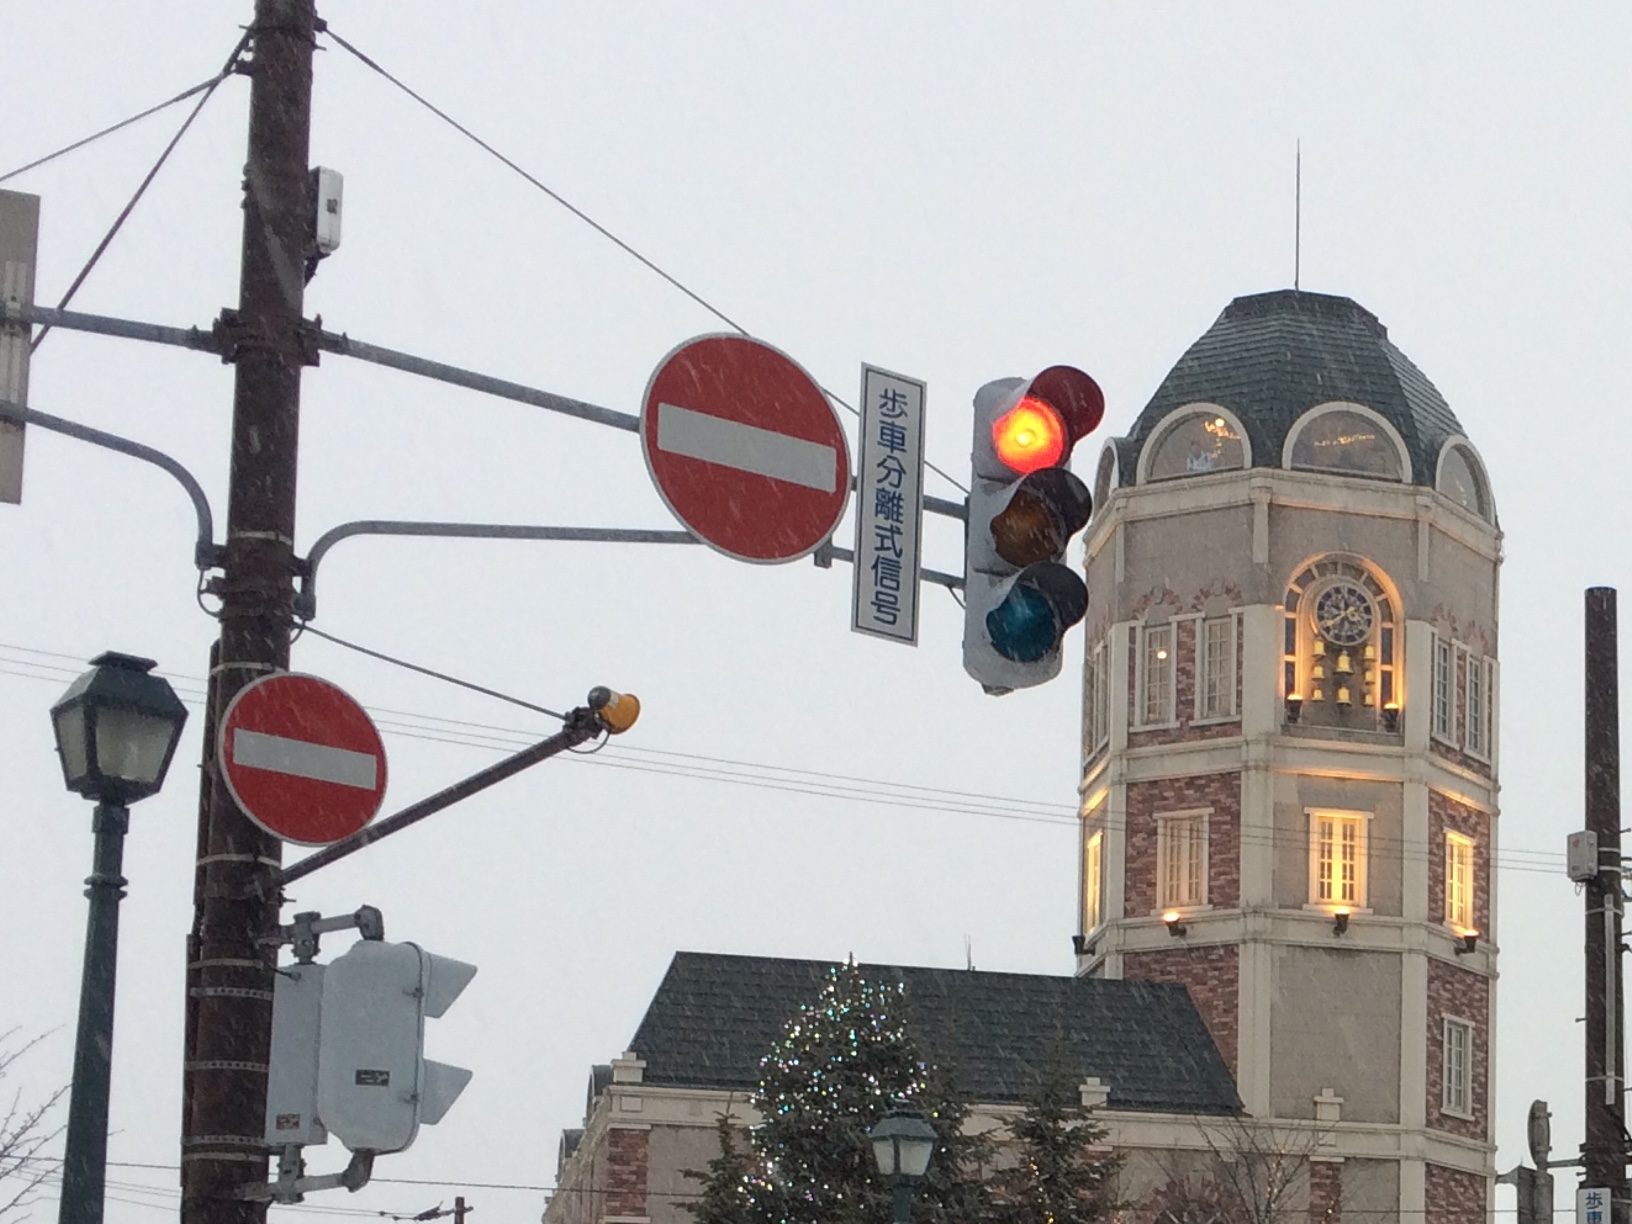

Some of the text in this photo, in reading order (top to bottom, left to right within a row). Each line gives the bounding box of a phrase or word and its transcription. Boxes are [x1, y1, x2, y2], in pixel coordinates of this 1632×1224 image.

[870, 388, 908, 626] 歩車分離式信号
